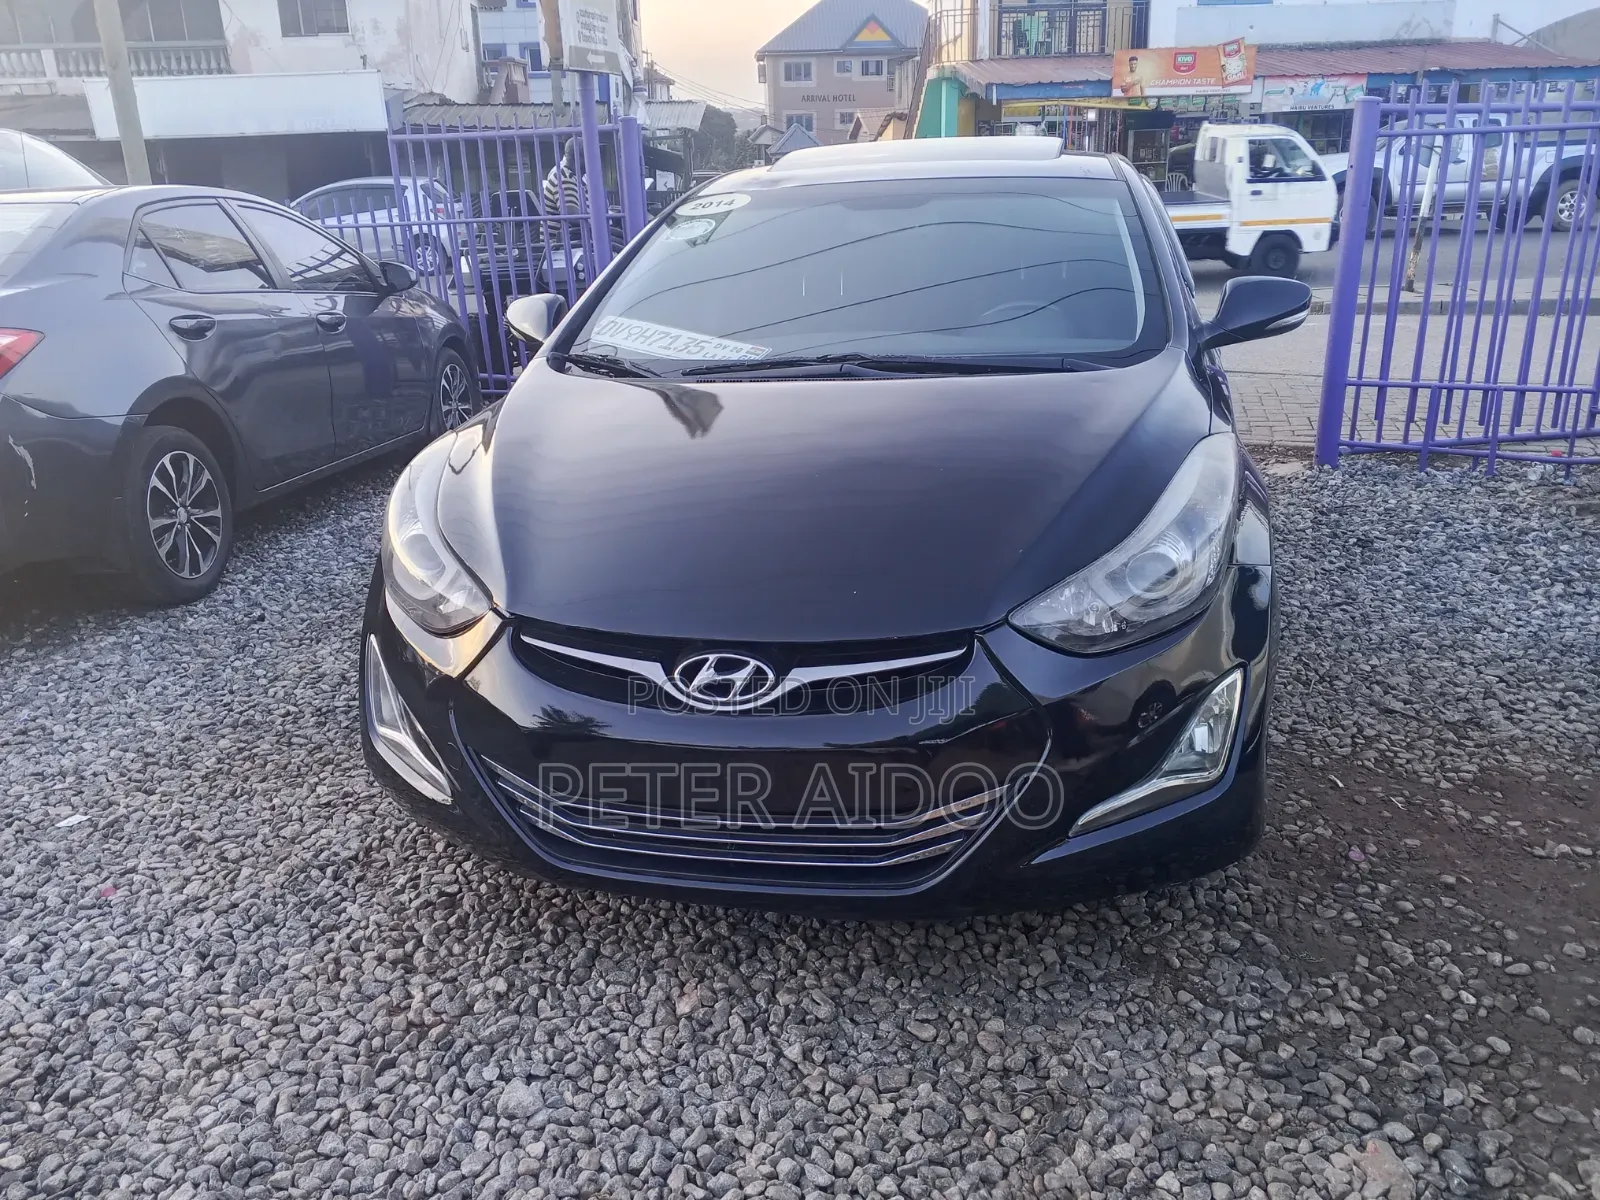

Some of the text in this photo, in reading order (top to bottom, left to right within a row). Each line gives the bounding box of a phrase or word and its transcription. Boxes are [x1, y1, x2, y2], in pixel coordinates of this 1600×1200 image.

[1150, 77, 1216, 86] CHAMPION TASTE
[801, 94, 856, 102] ARRIVAL HOTEL
[689, 199, 736, 211] 2014
